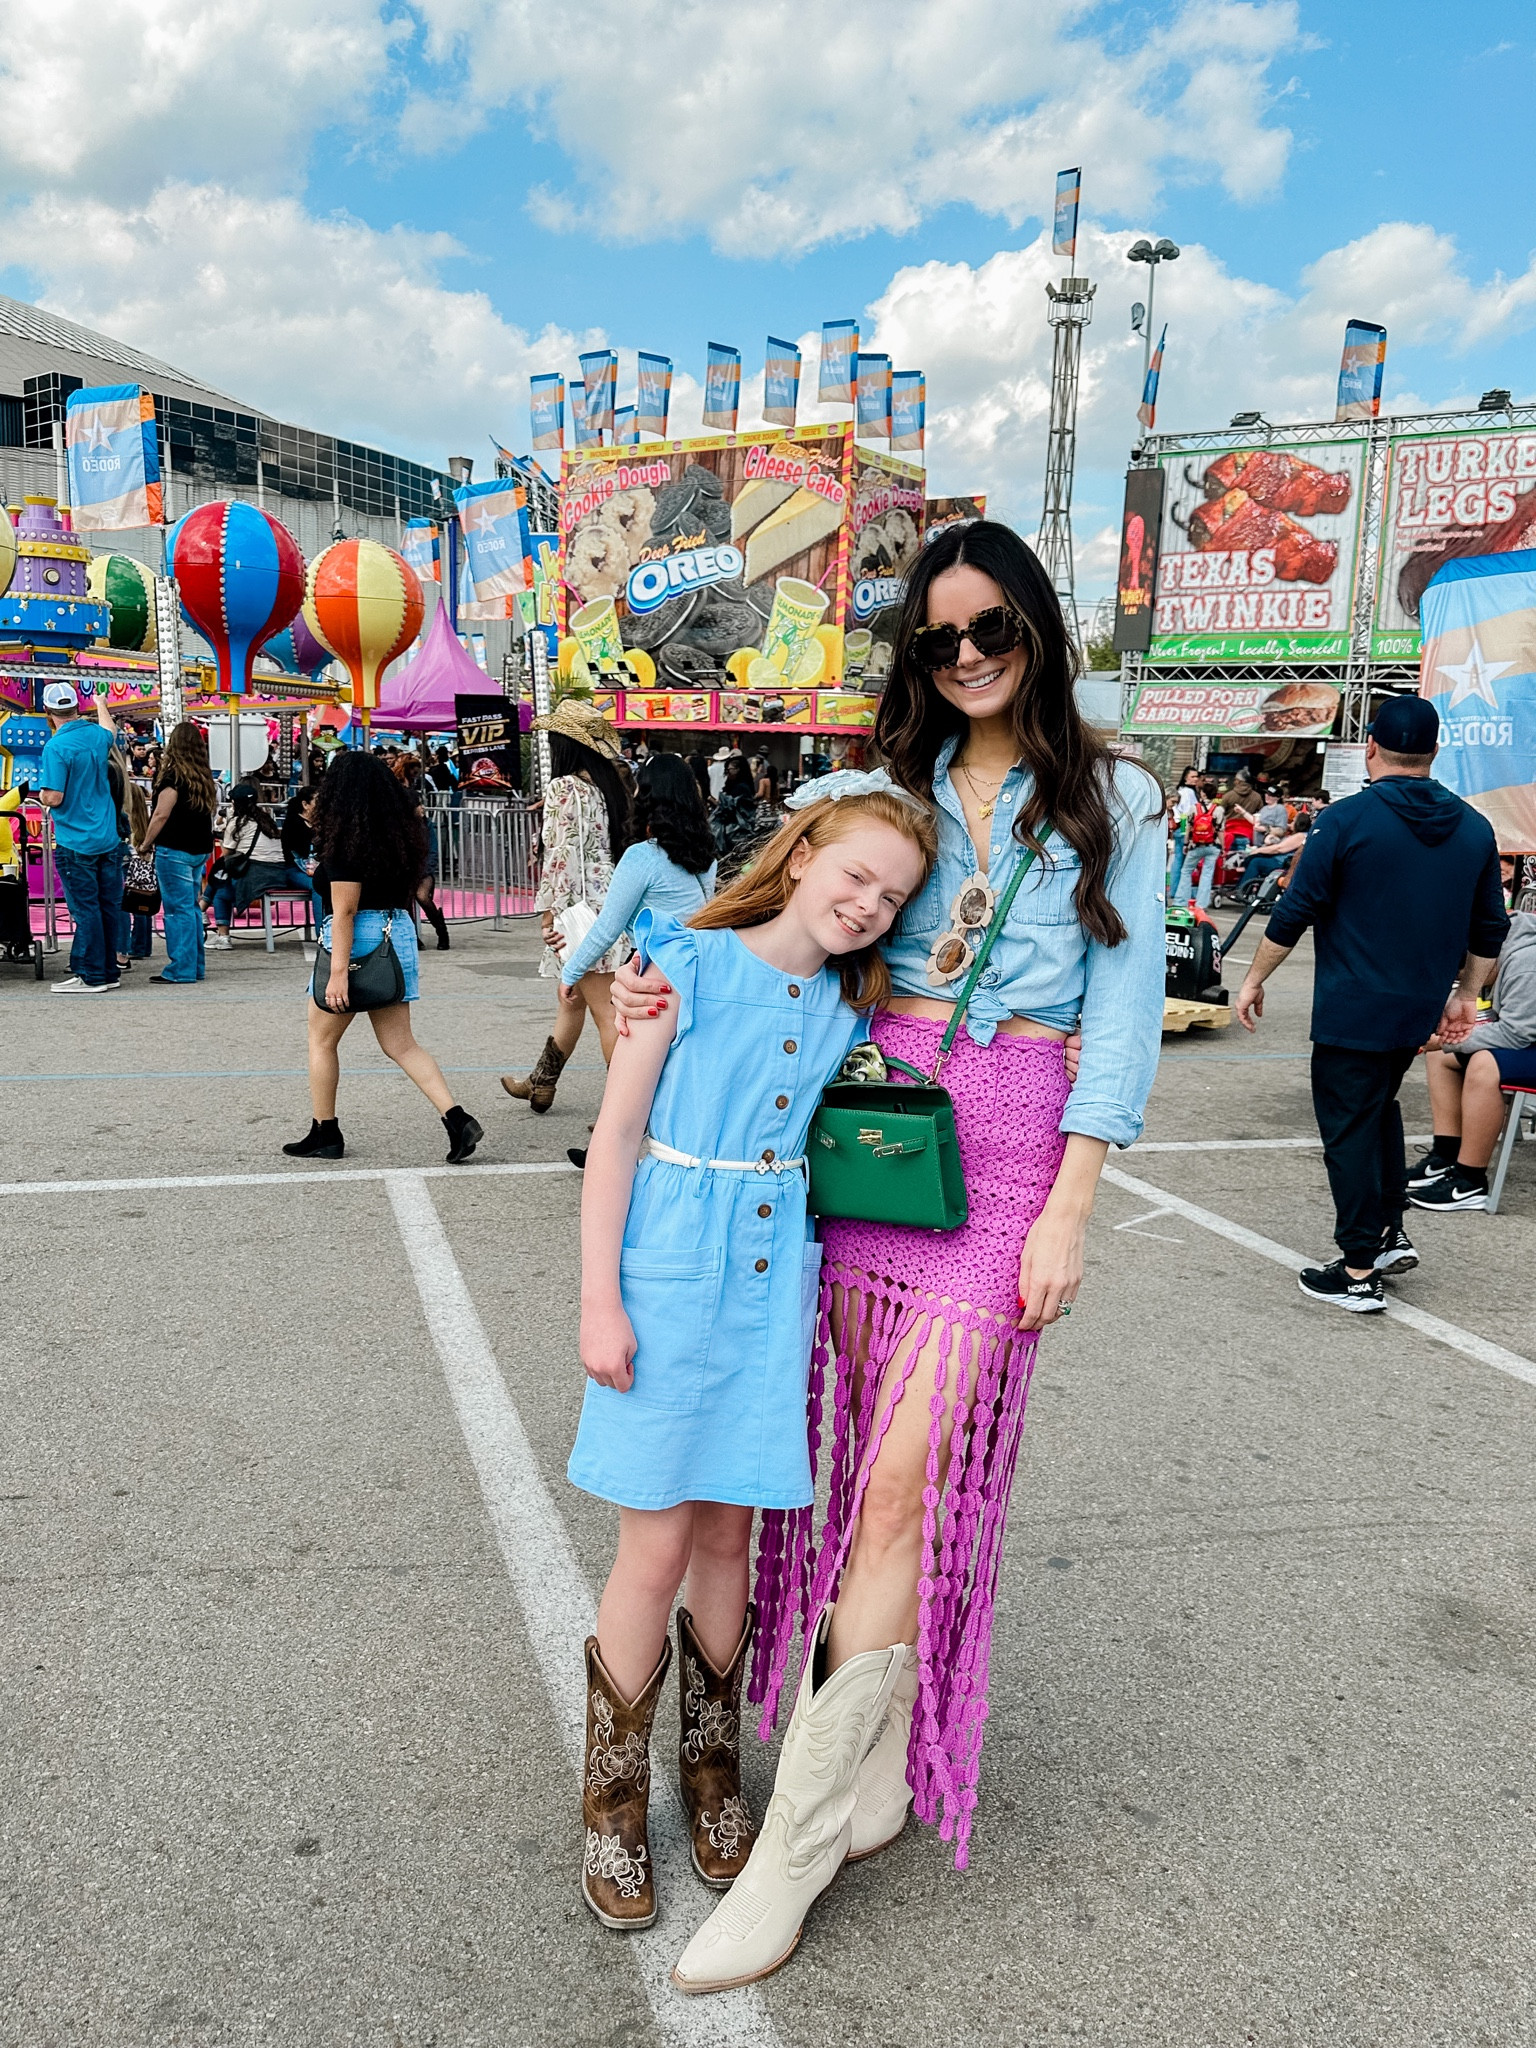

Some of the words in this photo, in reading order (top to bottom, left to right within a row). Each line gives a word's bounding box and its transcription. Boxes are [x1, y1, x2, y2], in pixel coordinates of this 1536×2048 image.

[776, 440, 805, 459] Deep
[807, 448, 841, 468] Fried
[743, 445, 802, 485] Cheese
[804, 463, 845, 504] Cake
[563, 478, 614, 533] Cookie
[617, 460, 671, 491] Dough
[854, 488, 889, 533] Cookie
[891, 484, 923, 512] Dough
[1397, 480, 1518, 528] LEGS
[639, 544, 670, 563] Deep
[671, 529, 706, 555] Fried
[628, 546, 743, 608] OREO
[1159, 549, 1276, 590] TEXAS
[777, 598, 817, 620] LEMONADE
[1156, 590, 1332, 632] TWINKIE
[578, 612, 613, 639] LEMONADE
[1150, 642, 1177, 658] Never
[1181, 641, 1226, 661] Frozen!
[1239, 638, 1284, 660] Locally
[1288, 640, 1342, 656] Sourced!
[1377, 638, 1412, 655] 100%
[1141, 688, 1206, 706] PULLED
[1209, 688, 1257, 705] PORK
[461, 716, 481, 724] FAST
[482, 713, 503, 721] PASS
[1134, 705, 1227, 724] SANDWICH
[462, 724, 504, 745] VIP
[1347, 1282, 1372, 1294] HOKA
